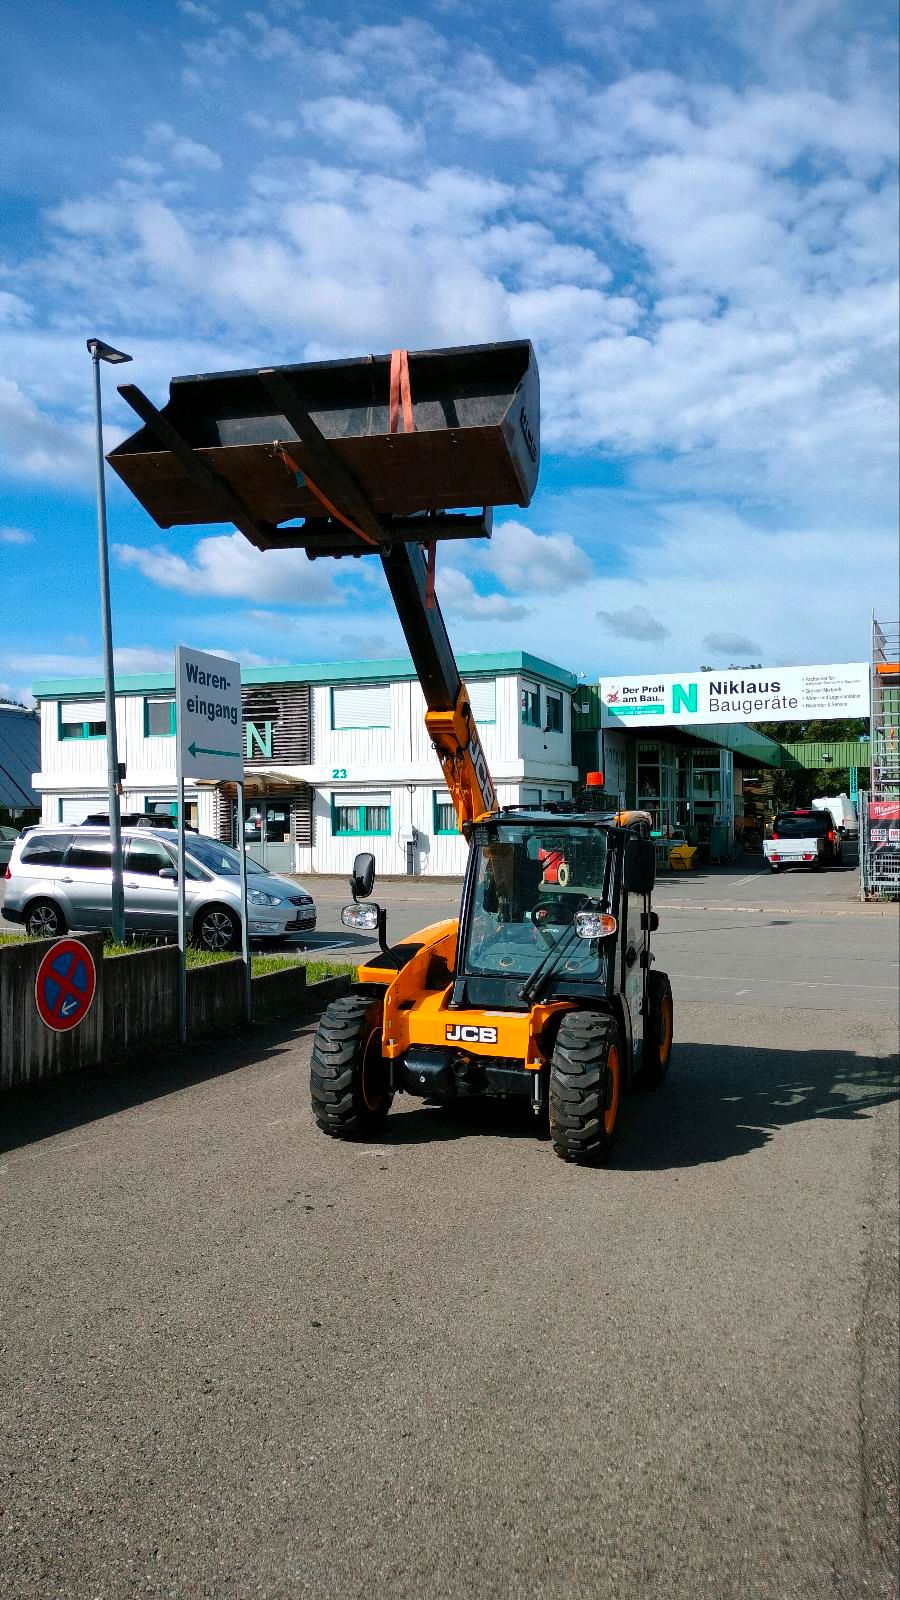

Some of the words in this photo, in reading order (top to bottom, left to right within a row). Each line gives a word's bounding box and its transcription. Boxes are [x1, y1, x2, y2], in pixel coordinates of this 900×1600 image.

[186, 663, 231, 690] Waren-
[642, 685, 664, 694] Profi
[709, 681, 781, 695] Niklaus
[672, 683, 698, 714] N
[709, 696, 798, 714] Baugeräte
[187, 695, 238, 725] eingang
[246, 721, 272, 758] N
[332, 768, 347, 779] 23
[446, 1025, 497, 1043] JCB
